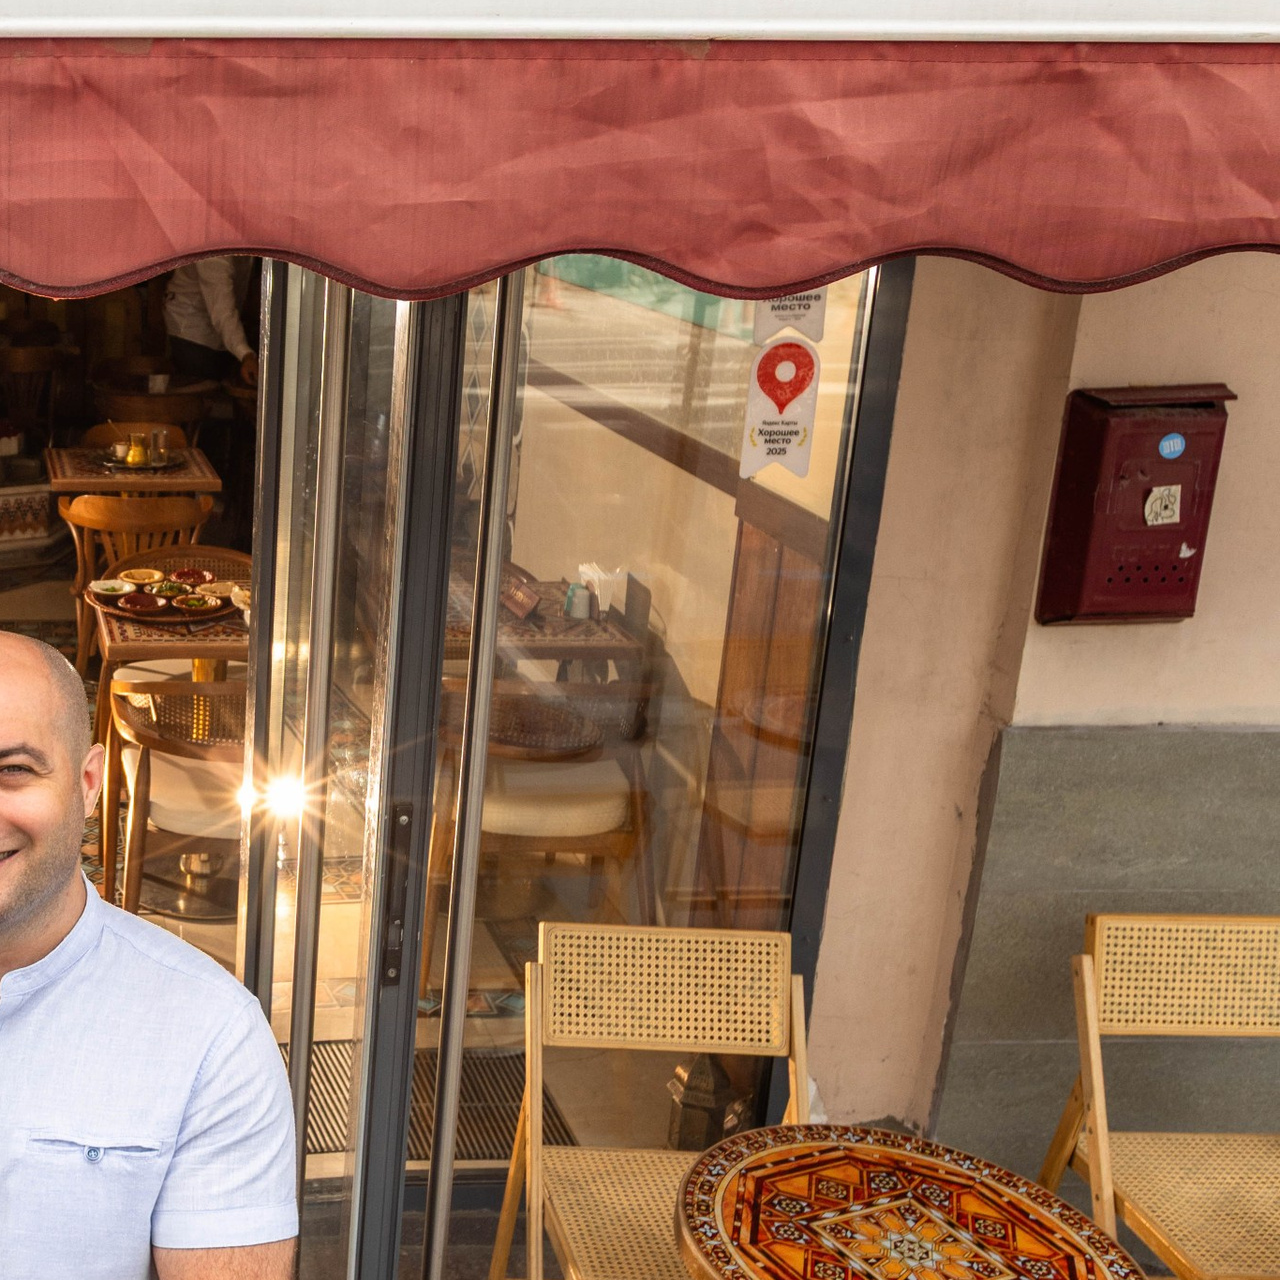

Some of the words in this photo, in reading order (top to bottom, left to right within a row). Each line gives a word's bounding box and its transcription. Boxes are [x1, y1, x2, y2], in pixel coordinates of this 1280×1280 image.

[771, 303, 811, 311] место
[758, 428, 800, 437] Хорошее
[766, 447, 787, 455] 2025
